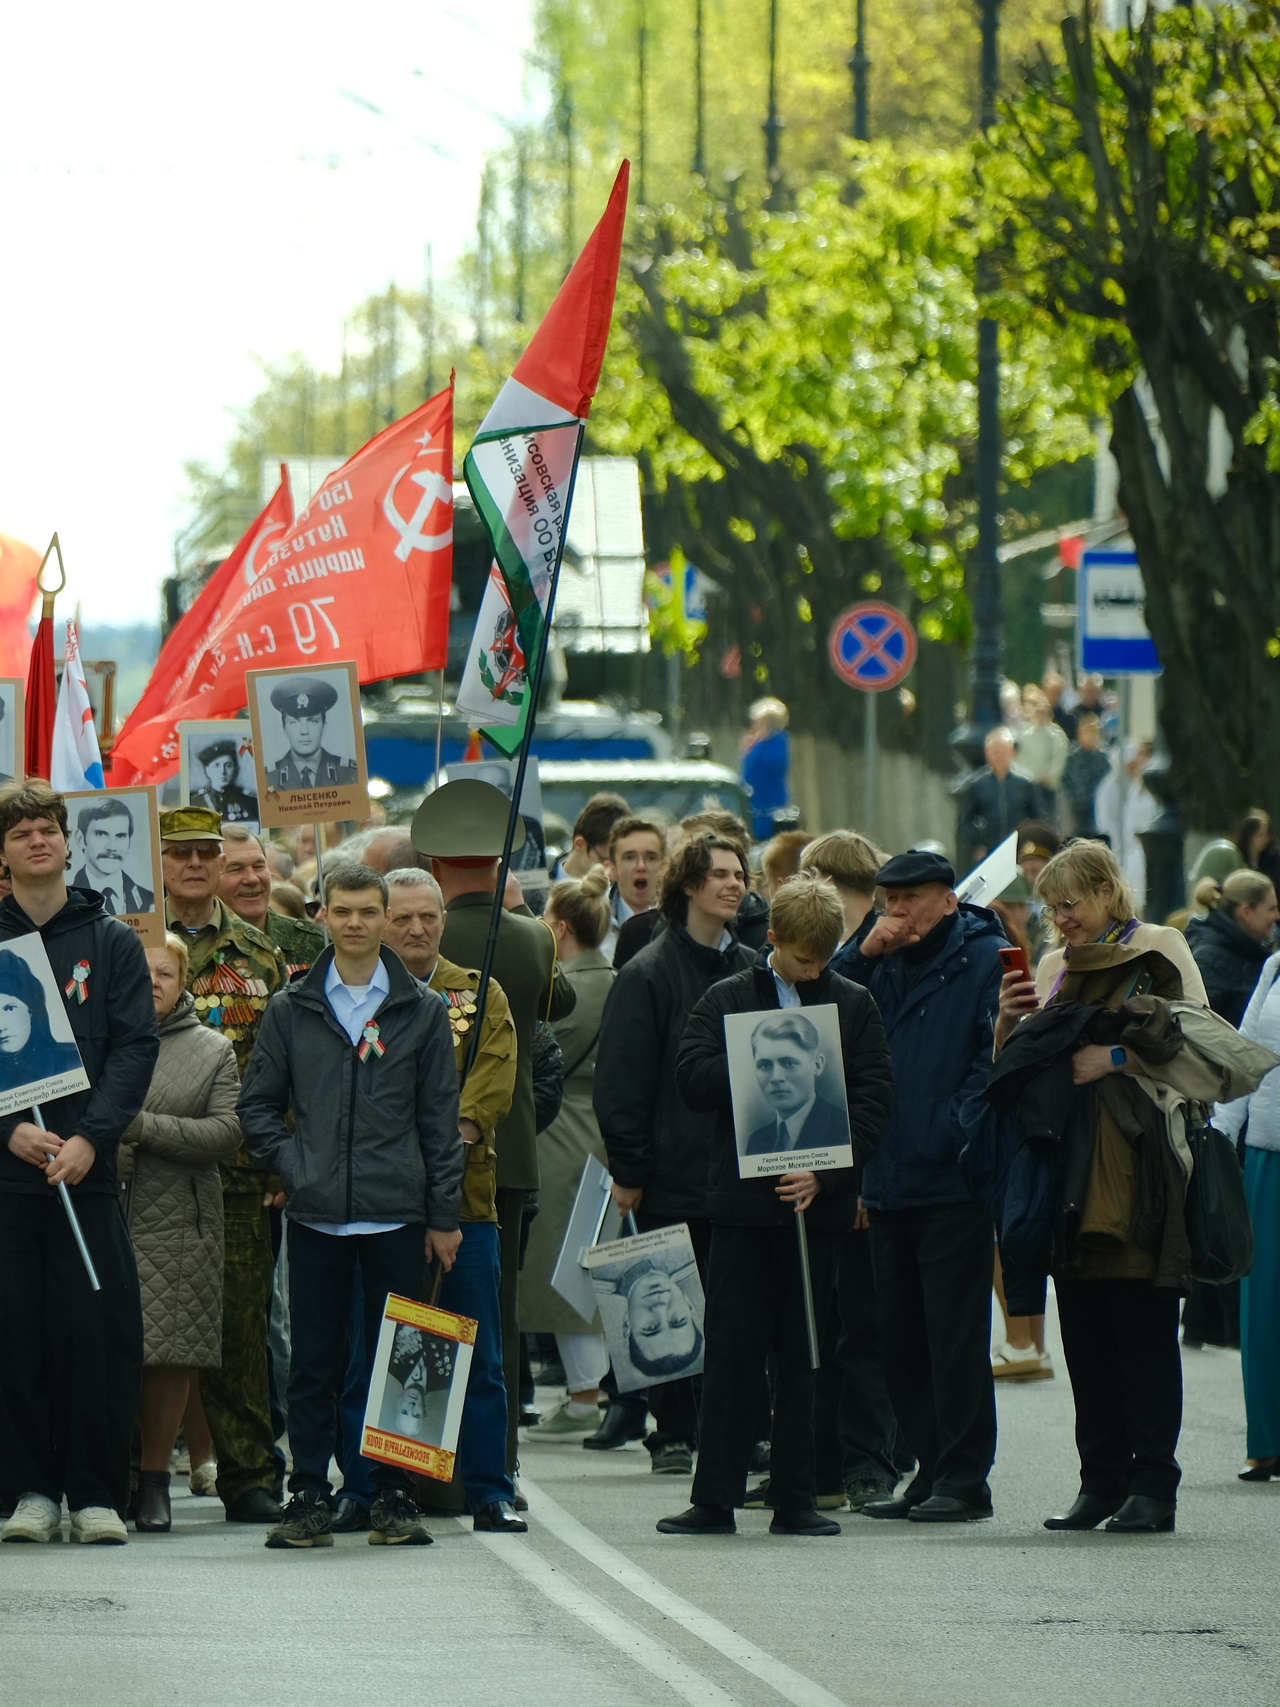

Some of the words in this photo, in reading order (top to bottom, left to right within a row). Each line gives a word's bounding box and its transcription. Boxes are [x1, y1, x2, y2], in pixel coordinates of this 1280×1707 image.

[290, 790, 338, 803] ЛЫСЕНКО
[278, 803, 312, 812] Николай
[314, 800, 351, 808] Петрович
[14, 1086, 46, 1098] Советского
[46, 1080, 64, 1088] Союза
[14, 1092, 50, 1107] Александр
[51, 1080, 84, 1095] Акимович
[780, 1154, 810, 1162] Советского
[757, 1165, 786, 1173] Морозов
